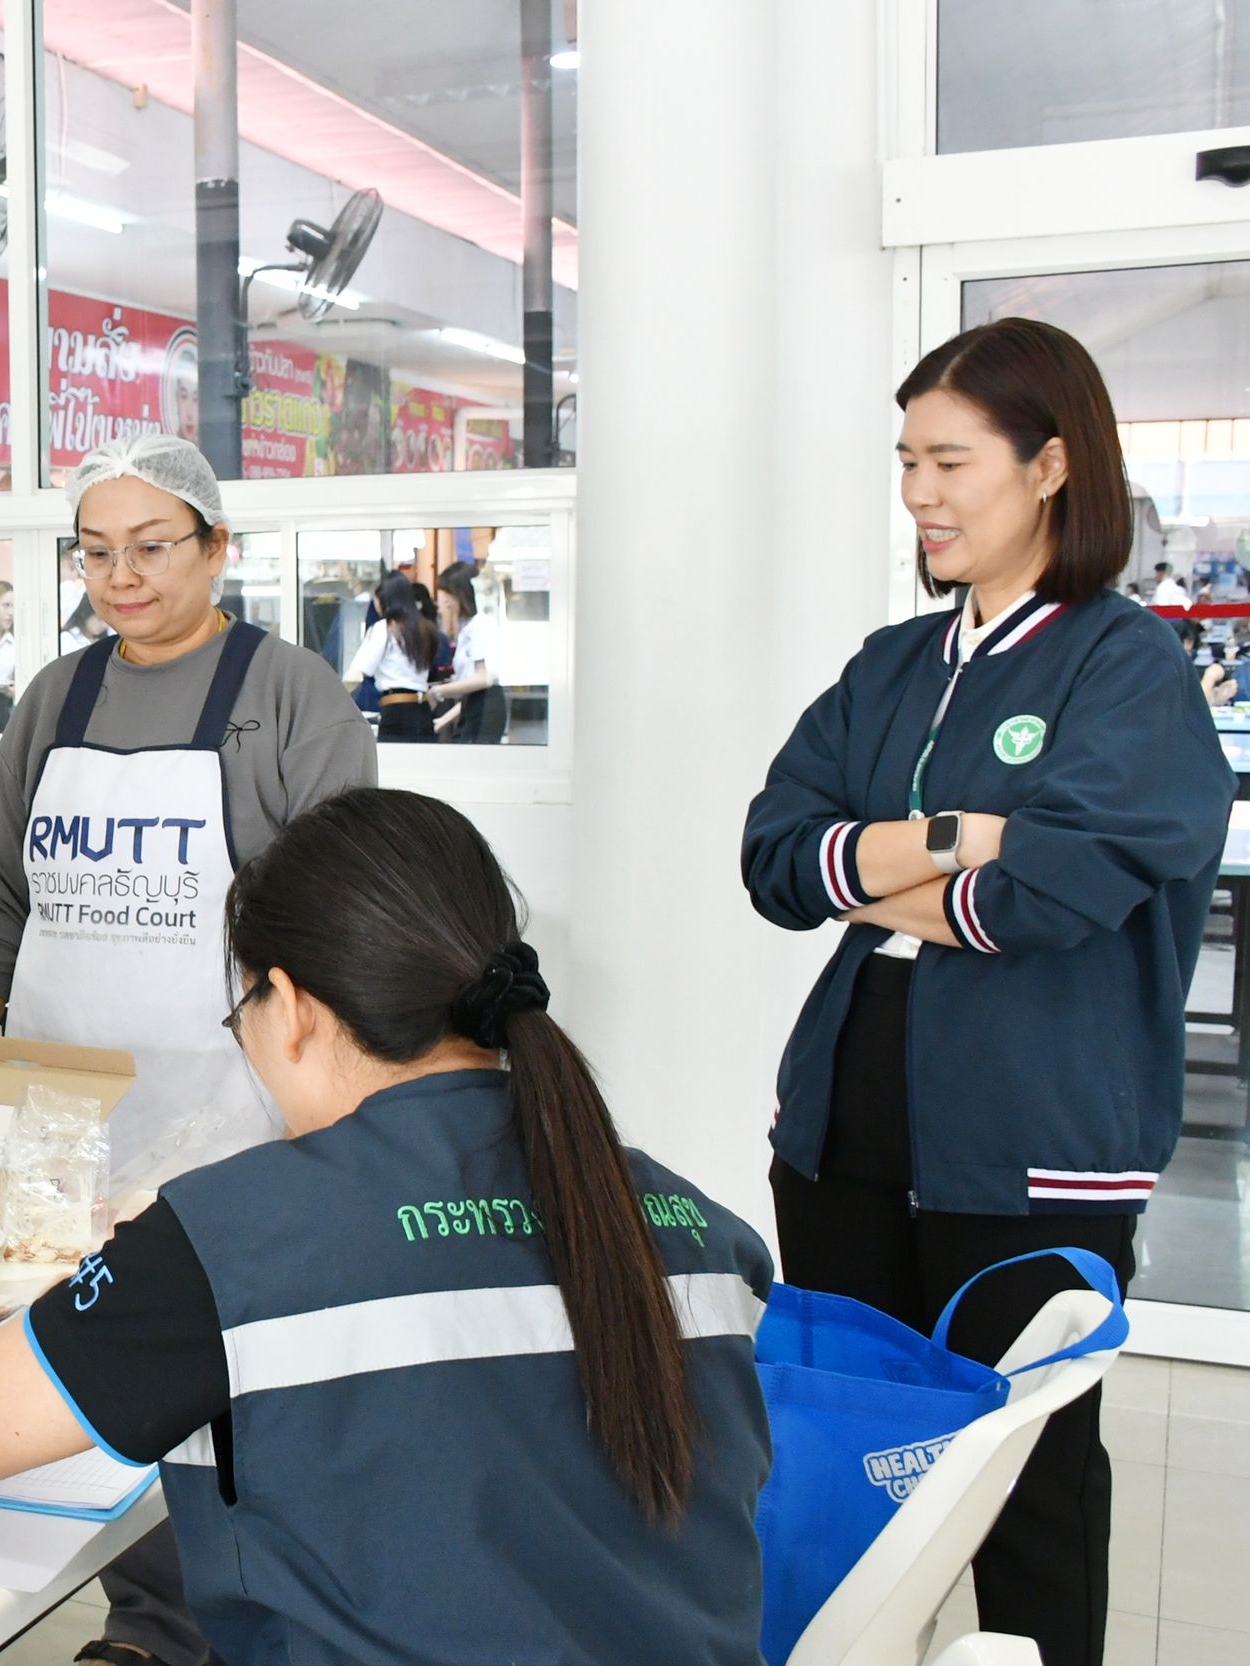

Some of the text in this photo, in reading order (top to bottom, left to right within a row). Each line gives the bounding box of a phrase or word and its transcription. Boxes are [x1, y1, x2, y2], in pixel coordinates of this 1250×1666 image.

[29, 815, 207, 865] RMUTT
[31, 868, 200, 905] ราชมงคลธัญบุรี
[78, 904, 130, 926] Food
[135, 906, 197, 929] Court
